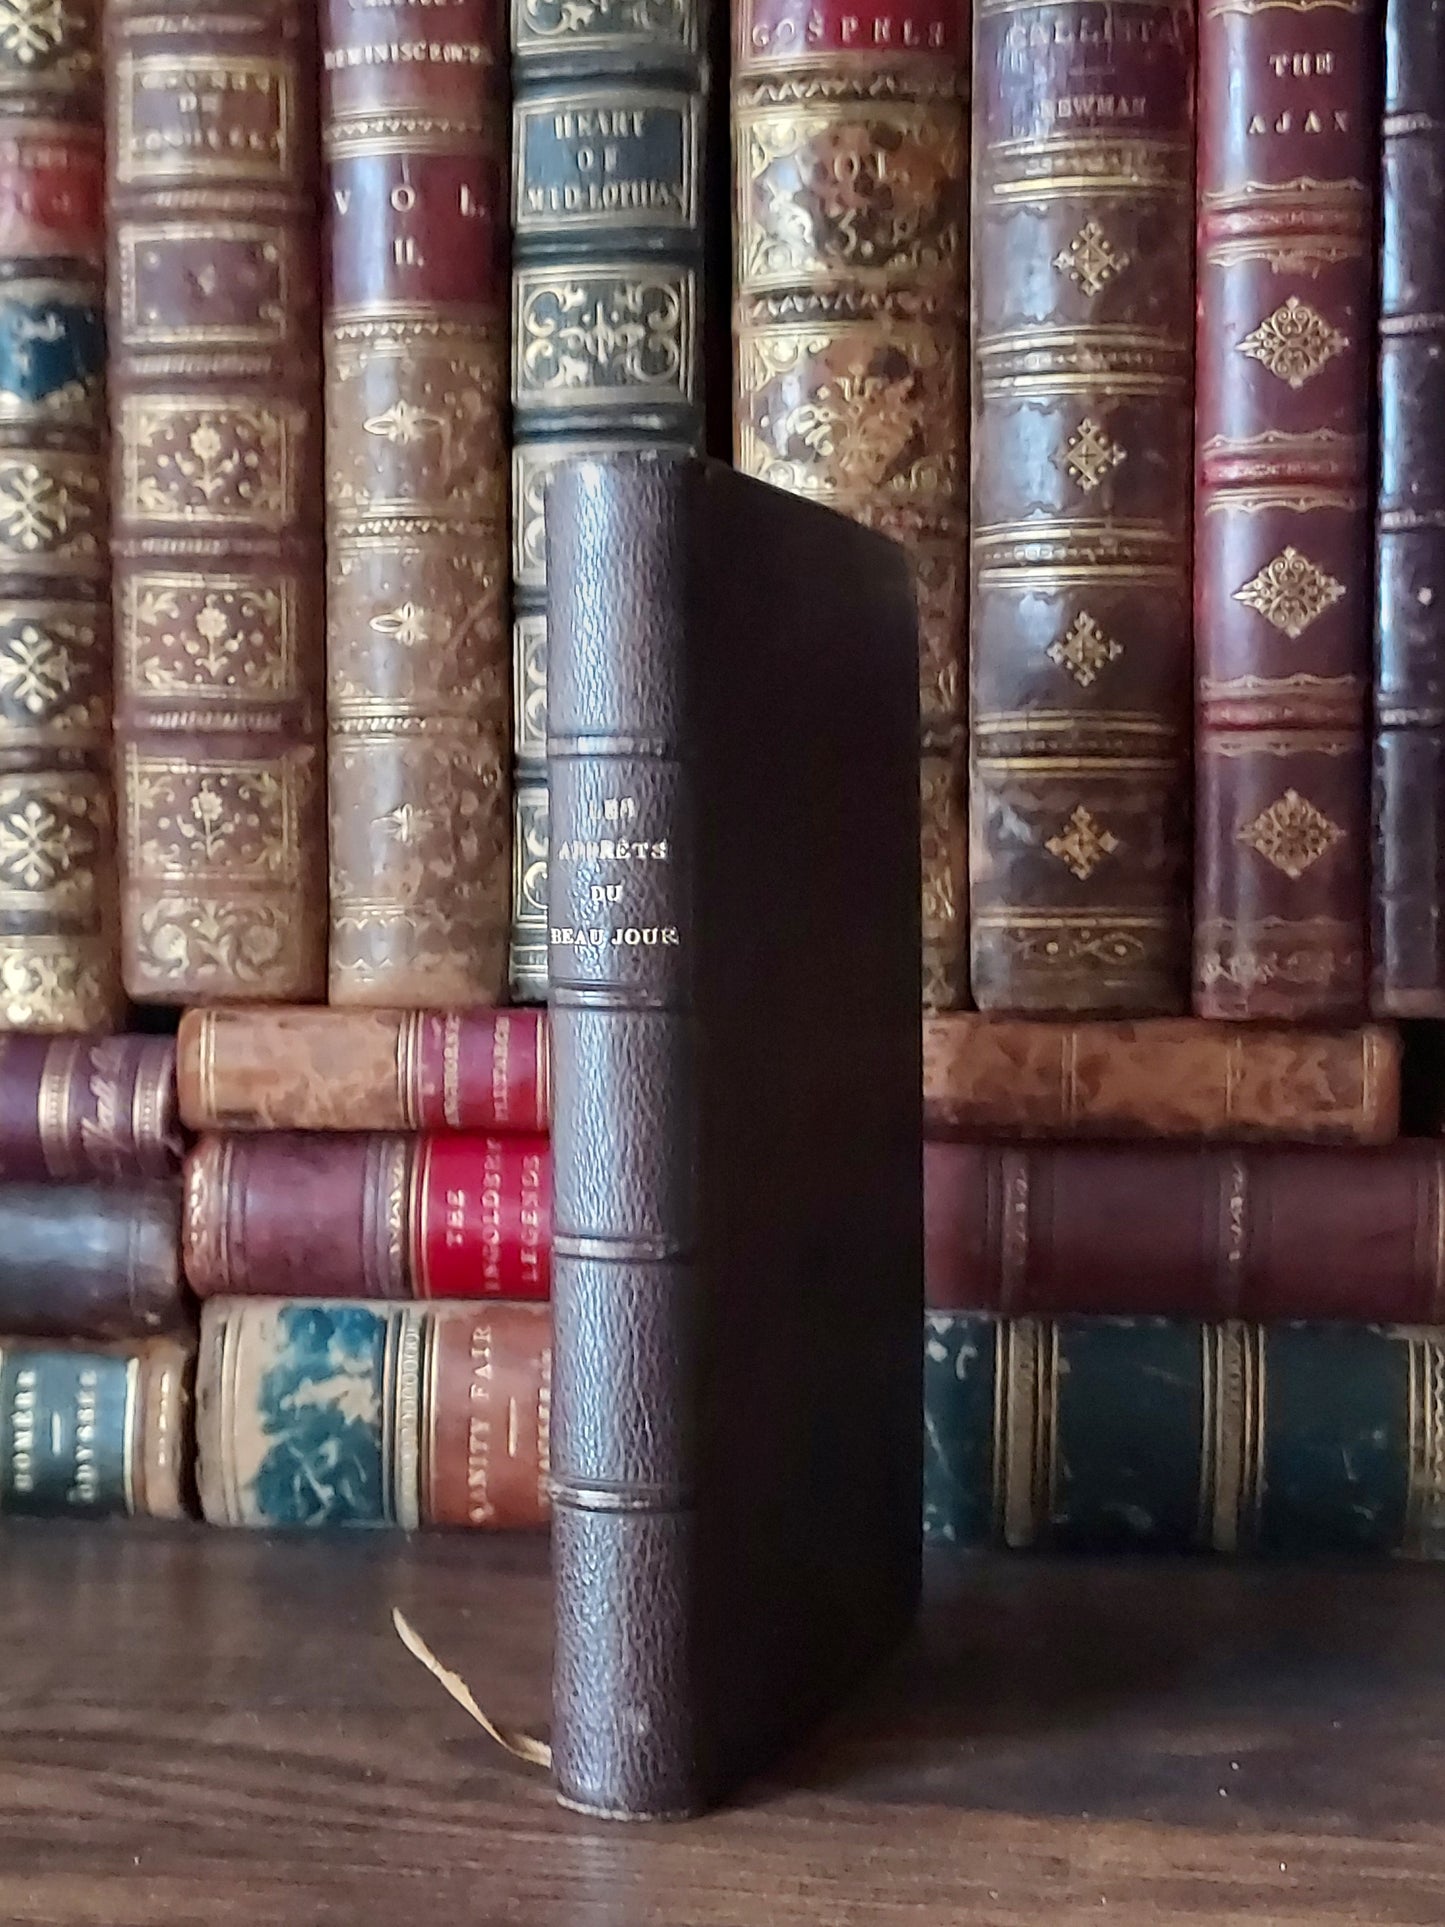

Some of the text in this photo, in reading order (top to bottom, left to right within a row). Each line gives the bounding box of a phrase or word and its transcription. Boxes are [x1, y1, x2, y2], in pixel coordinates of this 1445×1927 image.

[752, 9, 945, 46] GOSPELS
[1269, 52, 1333, 77] THE
[1249, 110, 1347, 134] AJAX
[591, 884, 622, 902] DU
[550, 927, 680, 946] BEAU JOUR
[470, 1325, 492, 1400] FAIR
